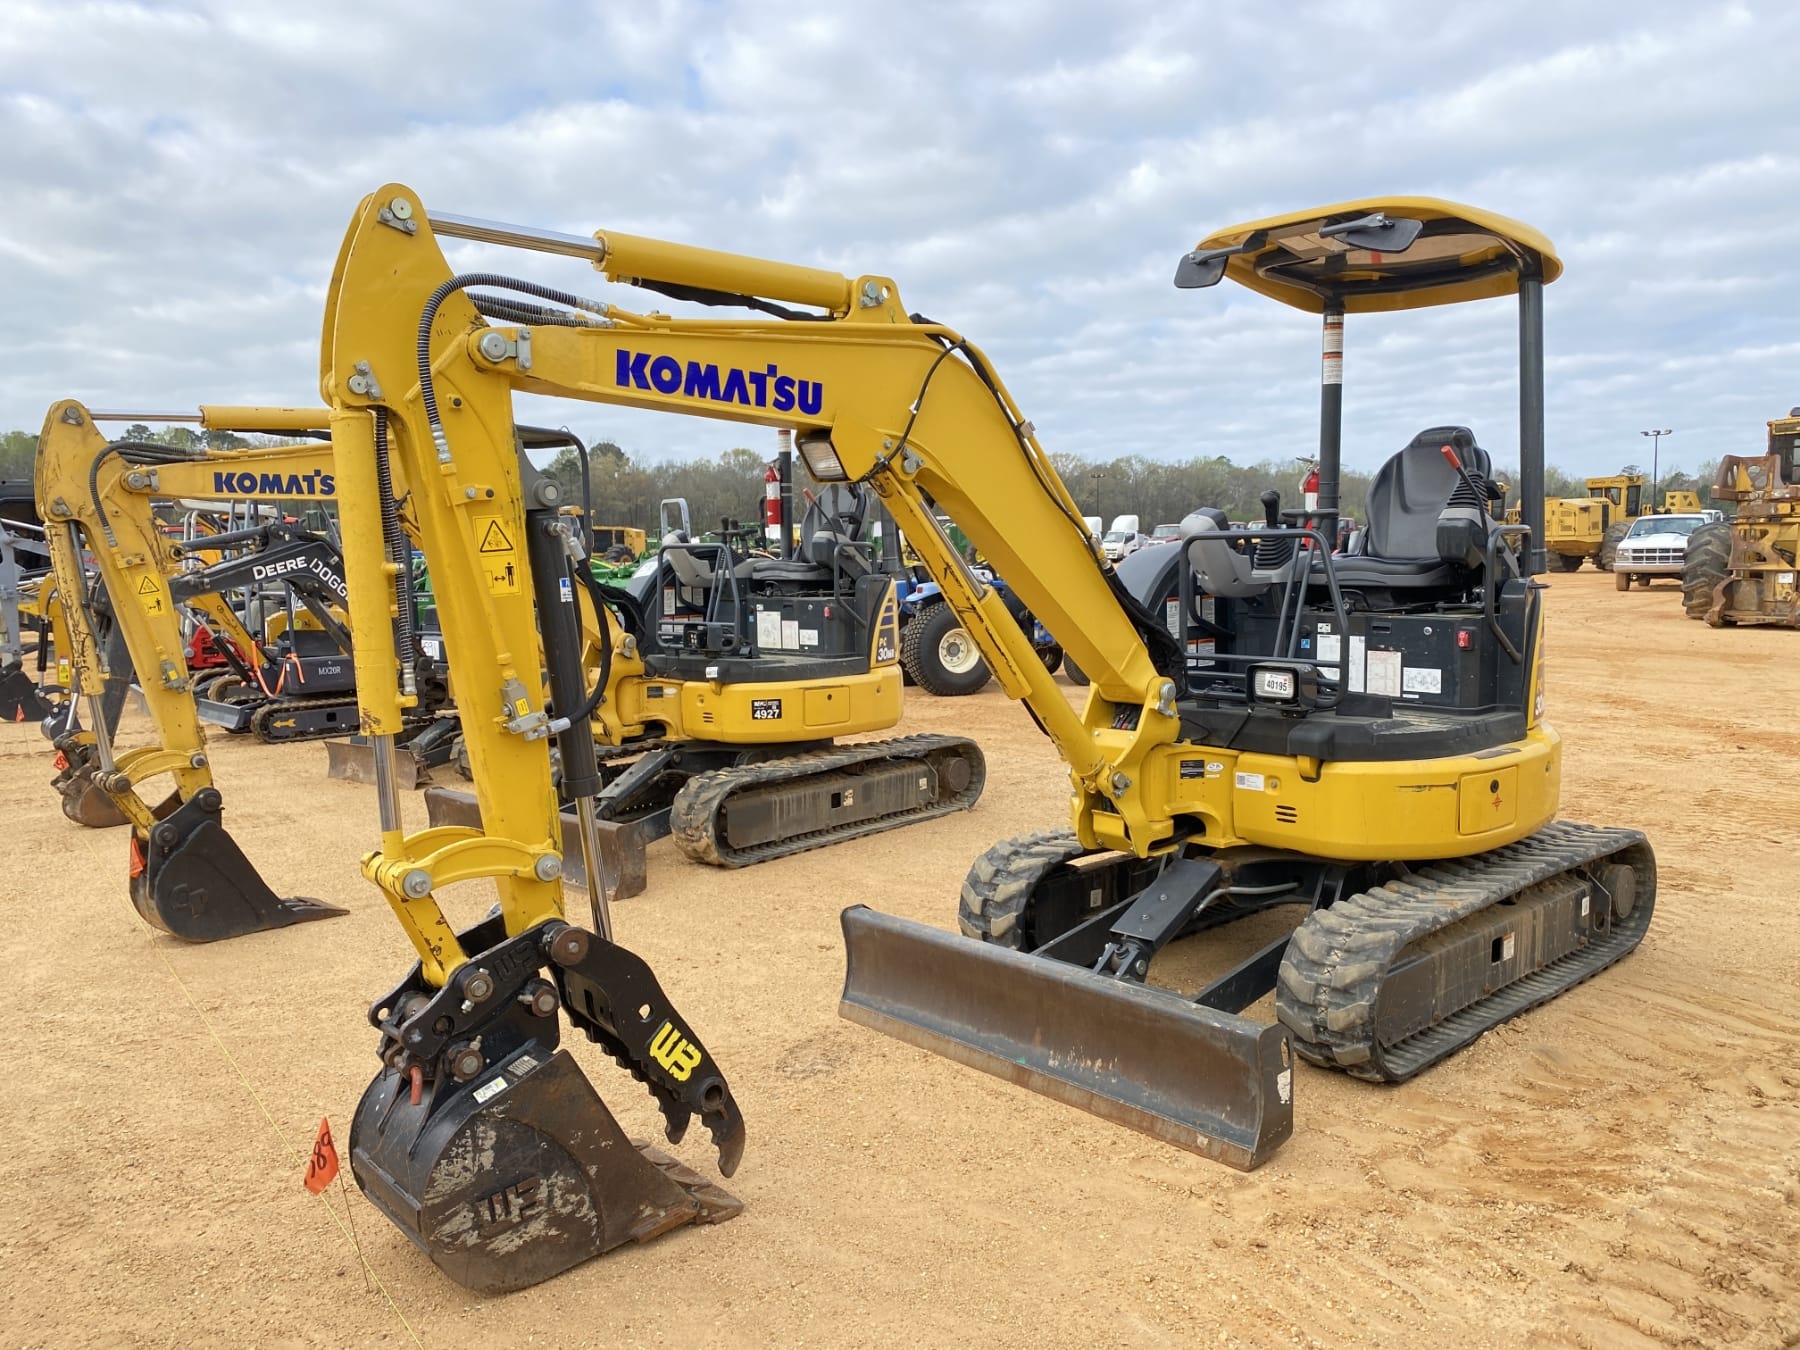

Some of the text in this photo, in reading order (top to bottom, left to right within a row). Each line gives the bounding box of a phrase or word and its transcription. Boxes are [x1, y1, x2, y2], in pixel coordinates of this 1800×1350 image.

[616, 349, 823, 415] KOMATSU
[214, 469, 336, 495] KOMATS
[252, 556, 308, 580] DEERE
[309, 558, 348, 600] DOGG
[754, 709, 780, 720] 4927
